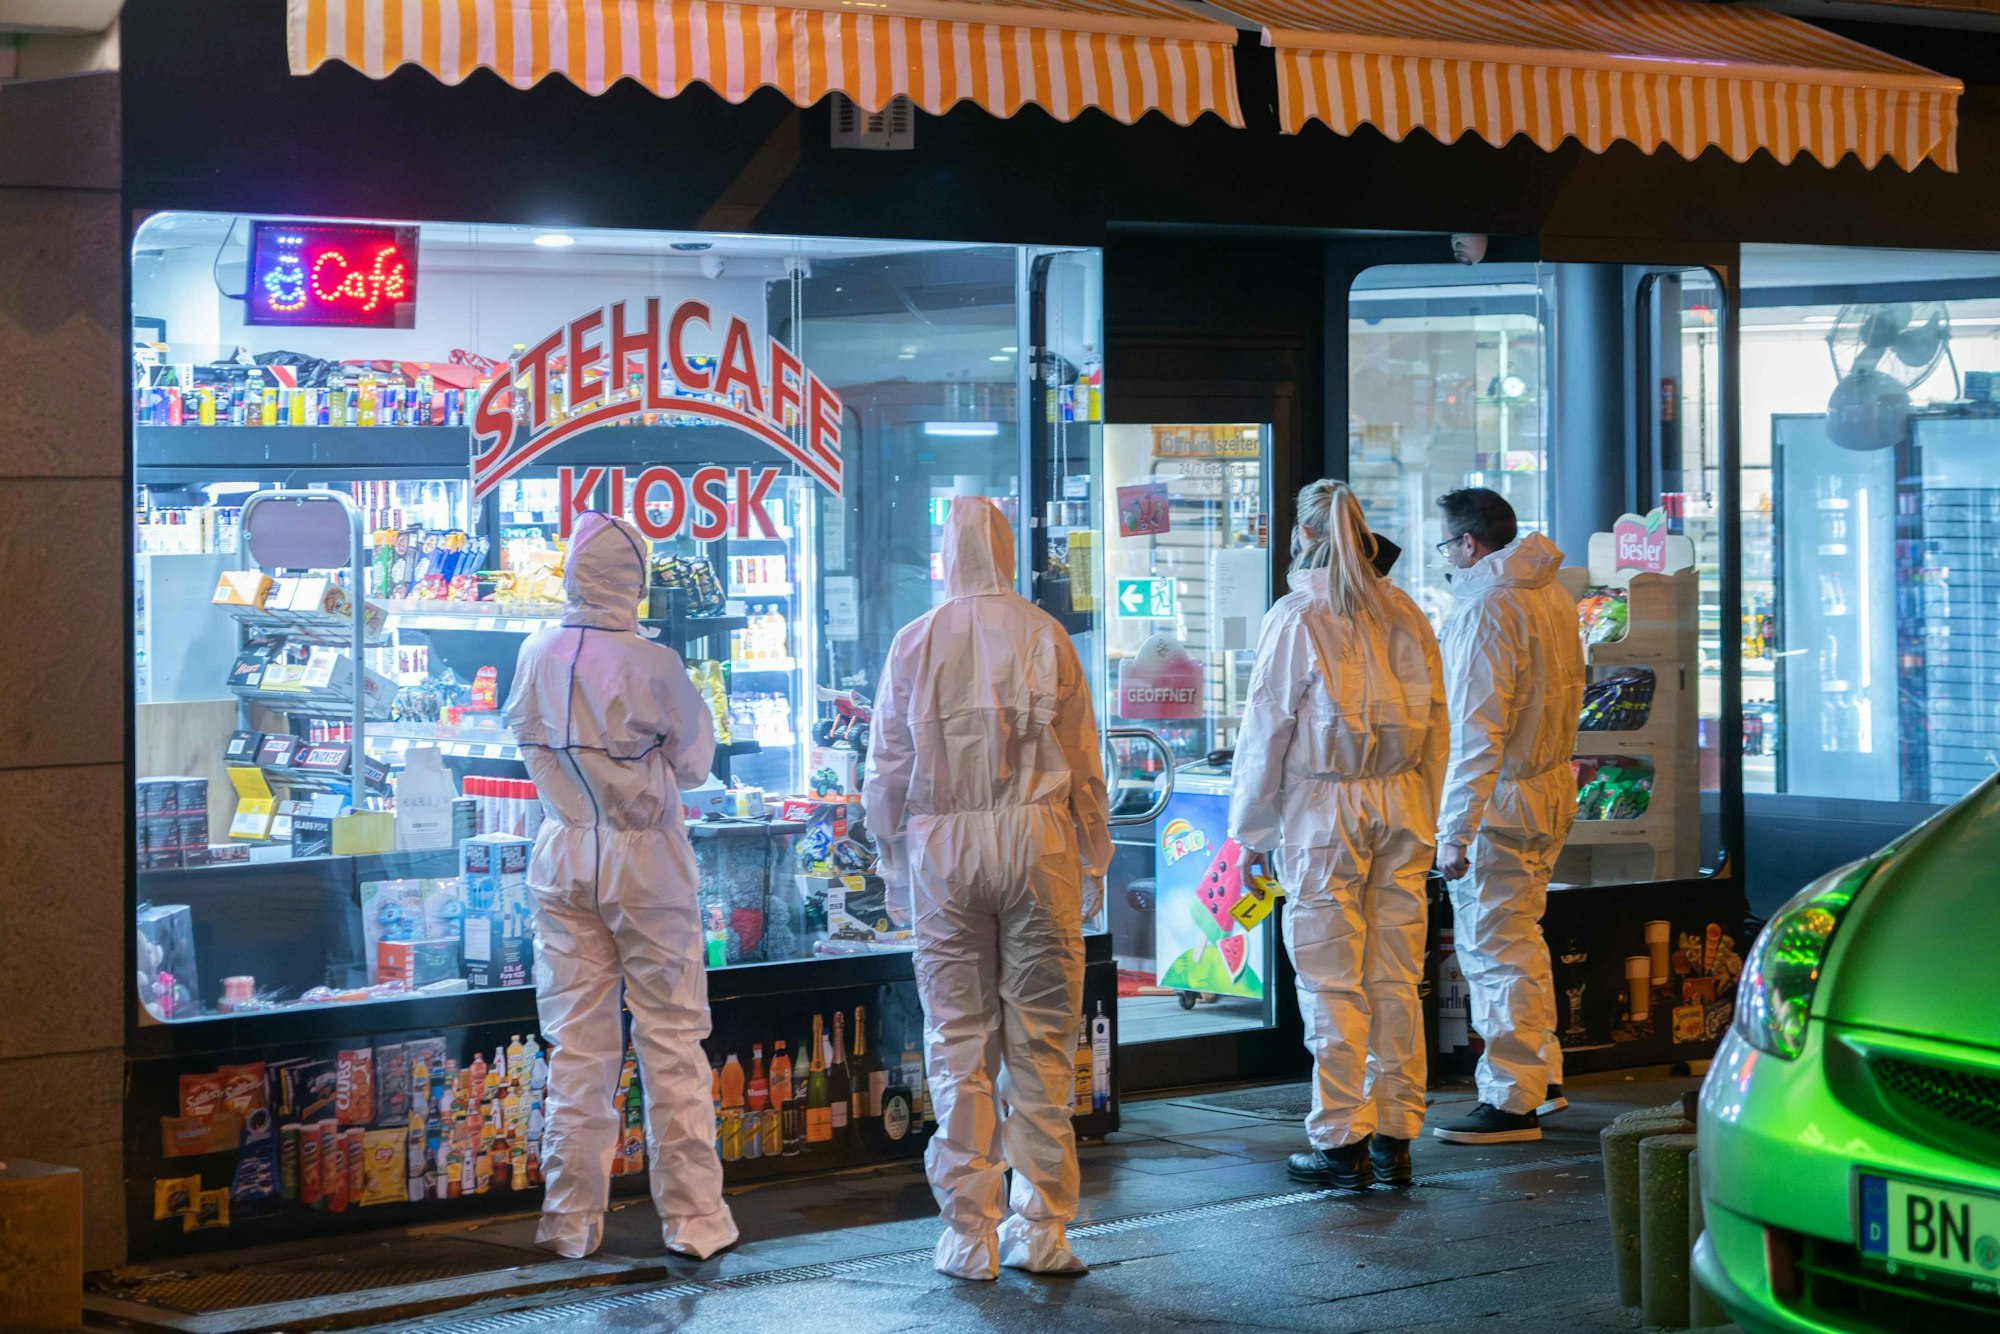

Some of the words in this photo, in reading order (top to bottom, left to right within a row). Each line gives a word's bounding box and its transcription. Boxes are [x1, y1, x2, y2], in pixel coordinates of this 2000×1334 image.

[311, 247, 405, 311] Café
[472, 296, 843, 482] STEHCAFE
[558, 466, 782, 543] KIOSK
[337, 1060, 352, 1110] CLUBS
[1906, 1193, 1971, 1264] BN
